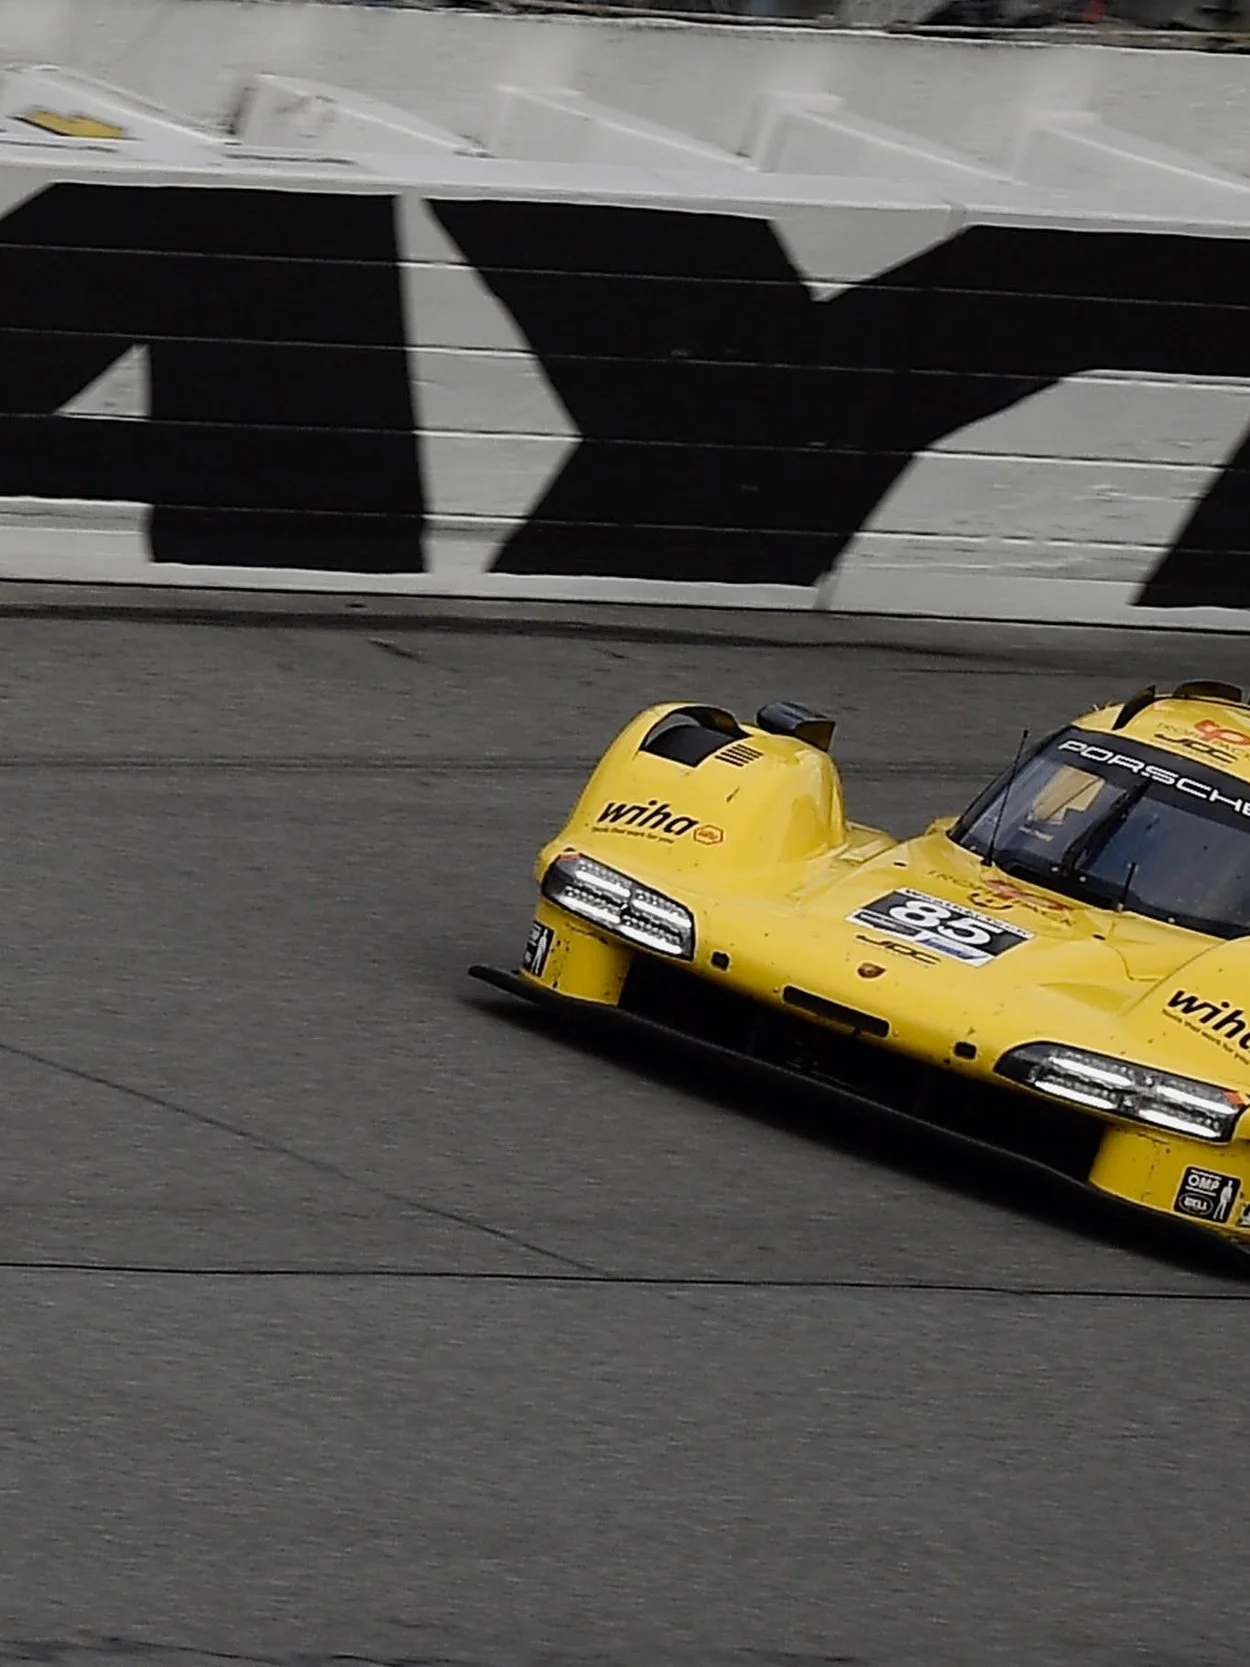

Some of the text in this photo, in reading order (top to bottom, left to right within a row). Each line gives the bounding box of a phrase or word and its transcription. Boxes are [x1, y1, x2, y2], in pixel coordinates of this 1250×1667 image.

[596, 799, 699, 836] wiha
[889, 899, 1004, 946] 85
[1187, 1174, 1220, 1192] OMP
